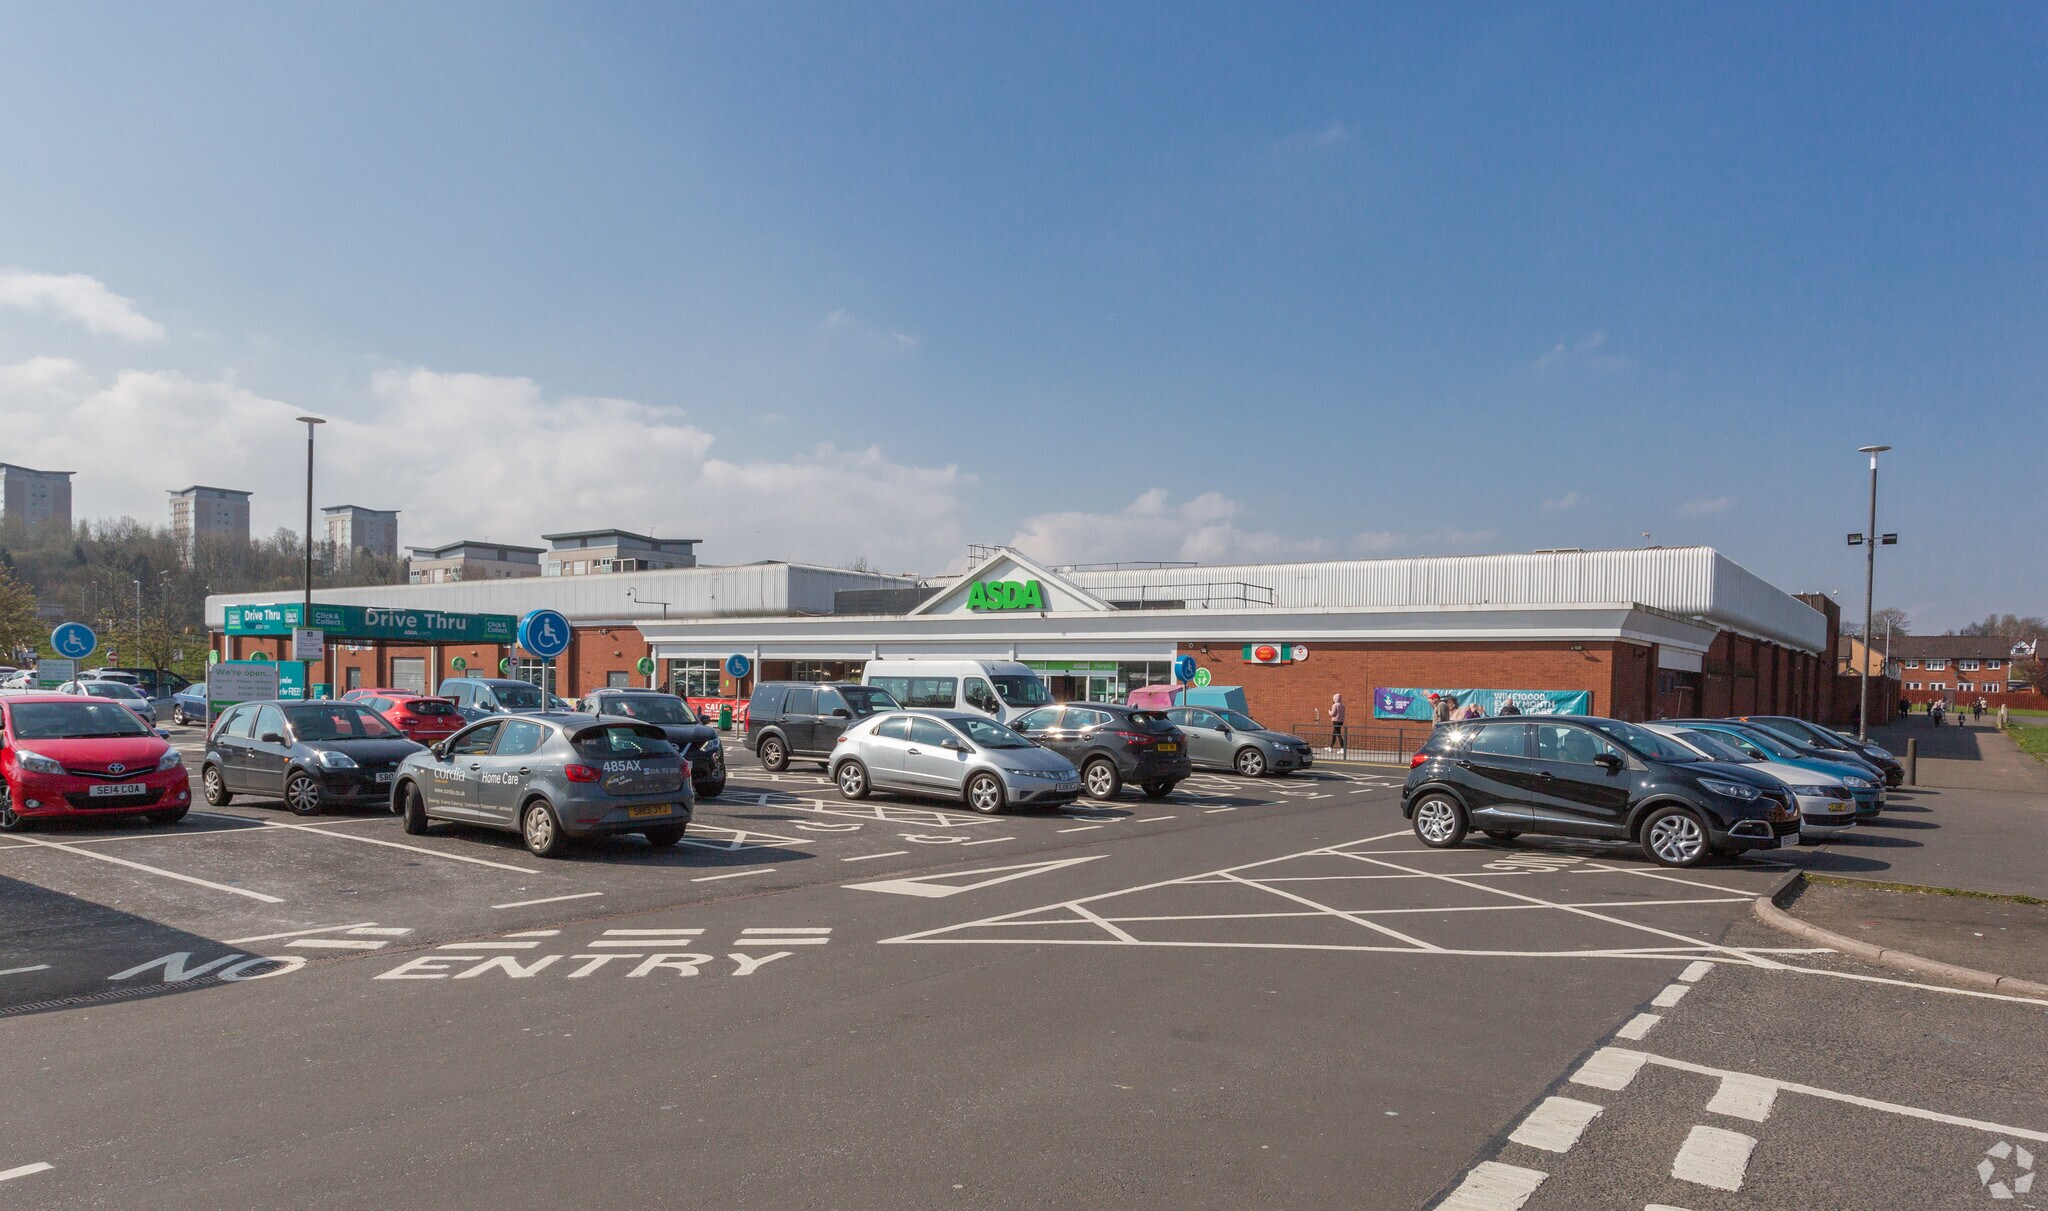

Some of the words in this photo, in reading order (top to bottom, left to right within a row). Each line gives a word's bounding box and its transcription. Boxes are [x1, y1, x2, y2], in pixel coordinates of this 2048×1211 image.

[966, 580, 1043, 609] ASDA
[244, 609, 263, 621] Drive
[264, 609, 281, 621] Thru
[365, 610, 418, 628] Drive
[424, 613, 467, 630] Thru
[315, 618, 341, 626] Collect
[215, 668, 242, 676] We're
[1494, 692, 1511, 700] WIN
[1522, 700, 1555, 708] MONTH
[602, 760, 642, 772] 485AX
[434, 767, 466, 782] cordia
[481, 771, 501, 784] Home
[502, 772, 518, 785] Care
[607, 777, 619, 785] Help
[96, 785, 119, 795] SE14
[121, 785, 140, 793] COA
[108, 951, 307, 982] NO
[373, 951, 797, 980] ENTRY
